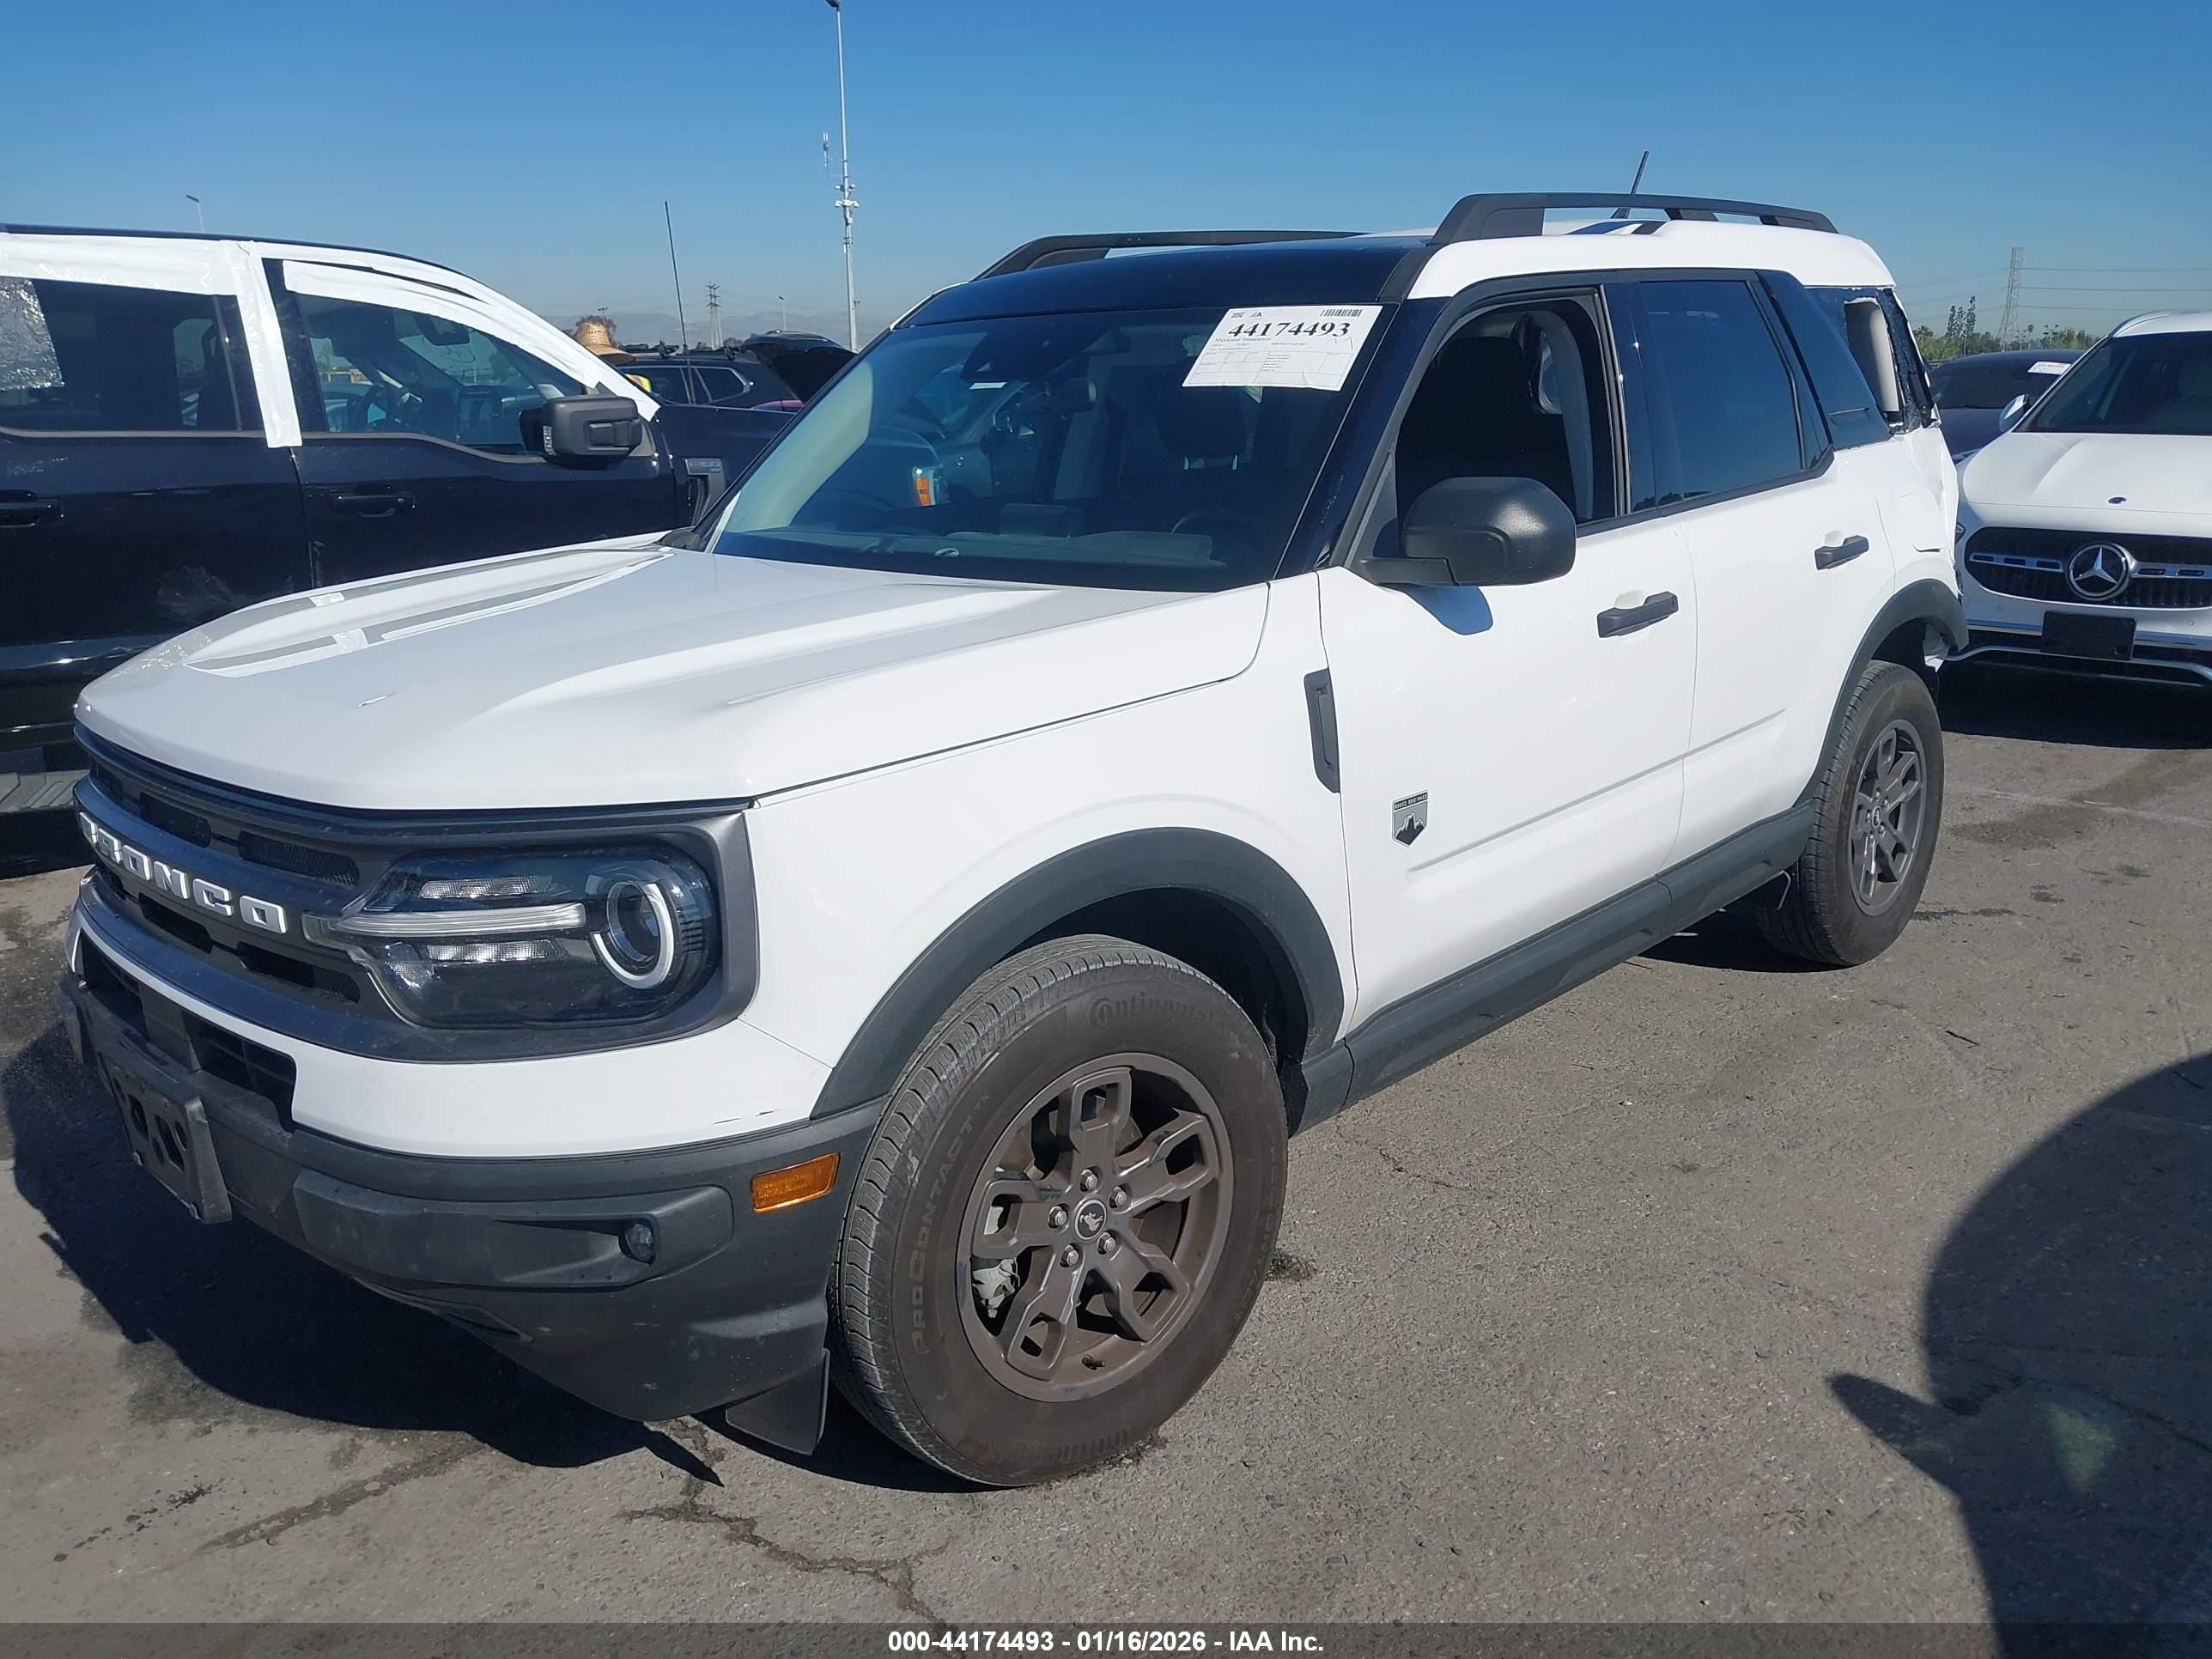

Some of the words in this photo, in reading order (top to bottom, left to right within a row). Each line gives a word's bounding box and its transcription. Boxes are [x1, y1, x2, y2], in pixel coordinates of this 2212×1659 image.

[1228, 322, 1351, 337] 44174493
[1408, 794, 1427, 805] BEND
[79, 811, 289, 934] BRONCO
